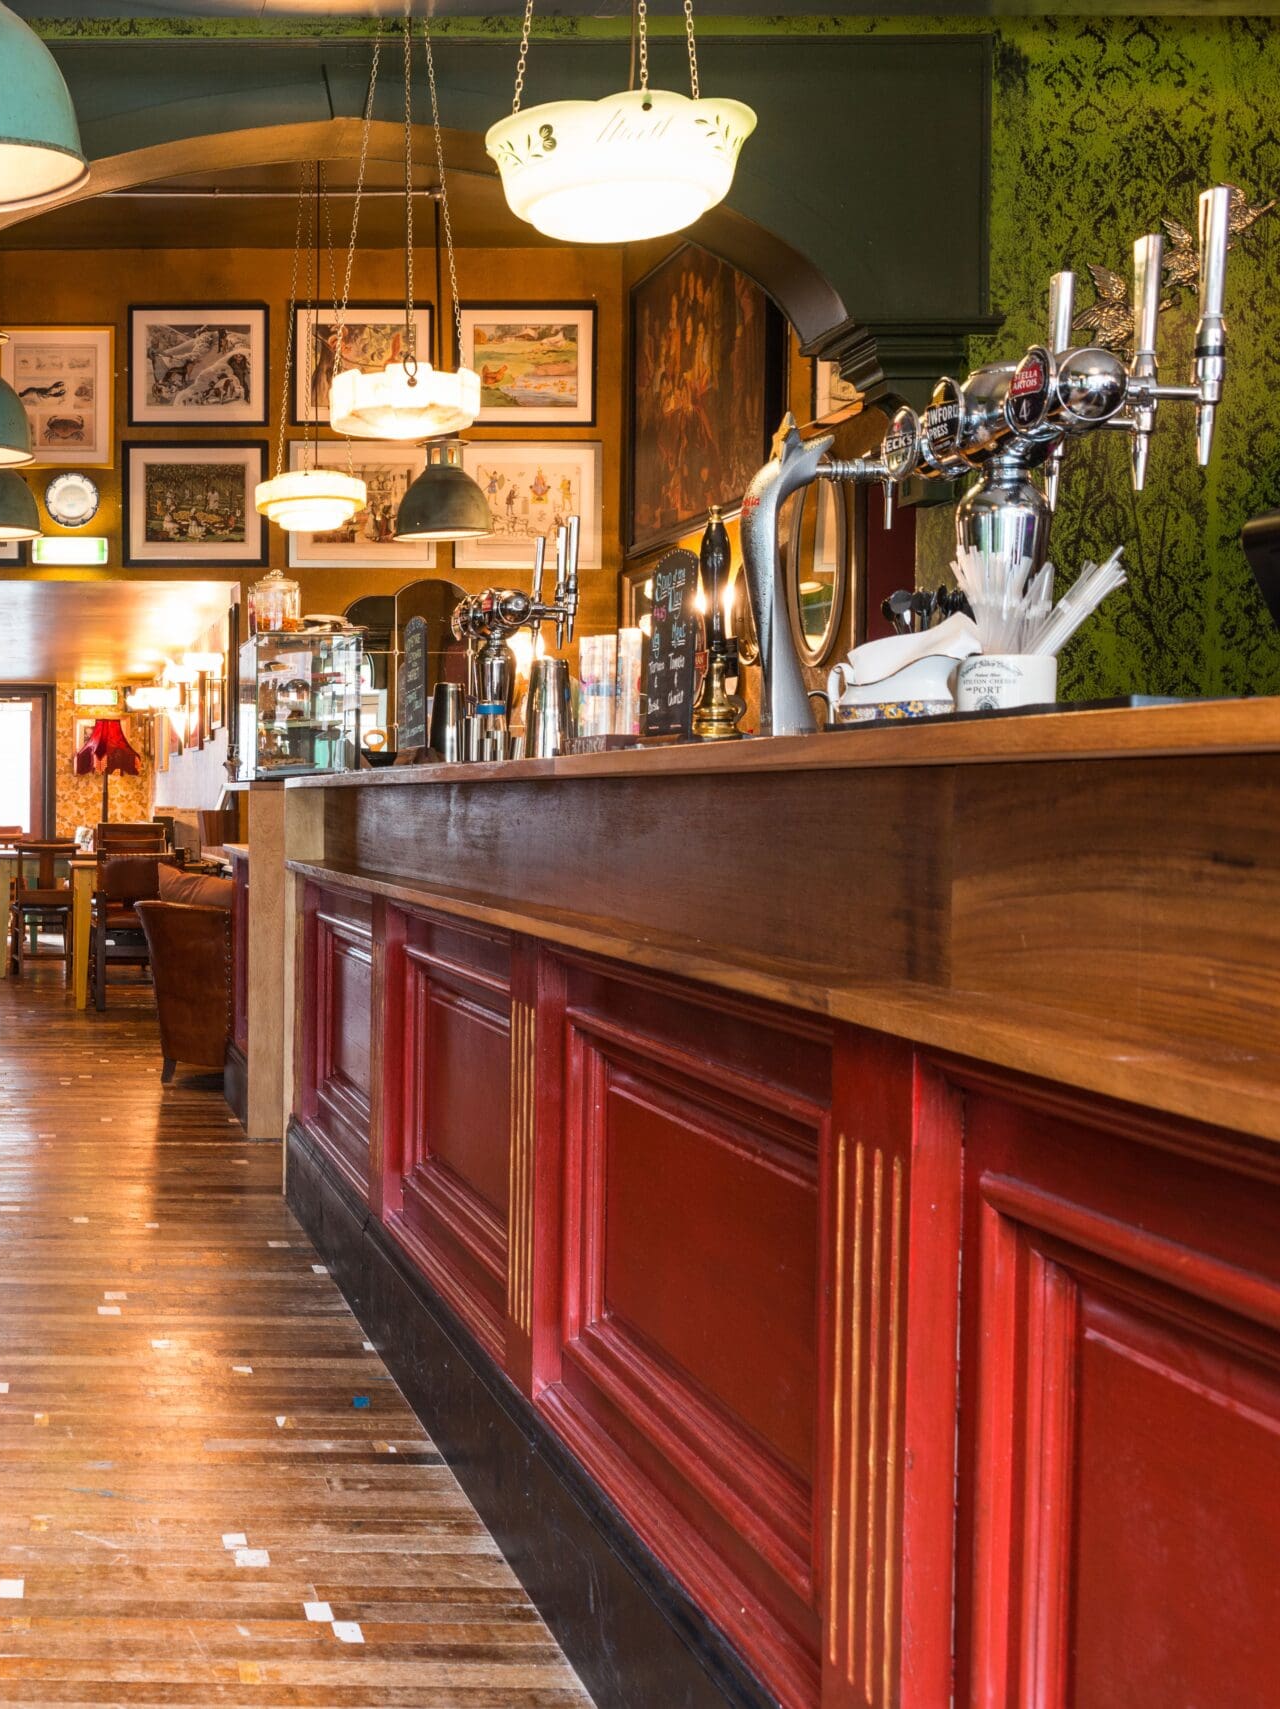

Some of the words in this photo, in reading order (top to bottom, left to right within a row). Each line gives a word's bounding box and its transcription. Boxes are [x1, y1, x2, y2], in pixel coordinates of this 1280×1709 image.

[1014, 369, 1038, 381] STELLA
[1013, 378, 1038, 391] ARTOIS
[973, 686, 1002, 694] PORT
